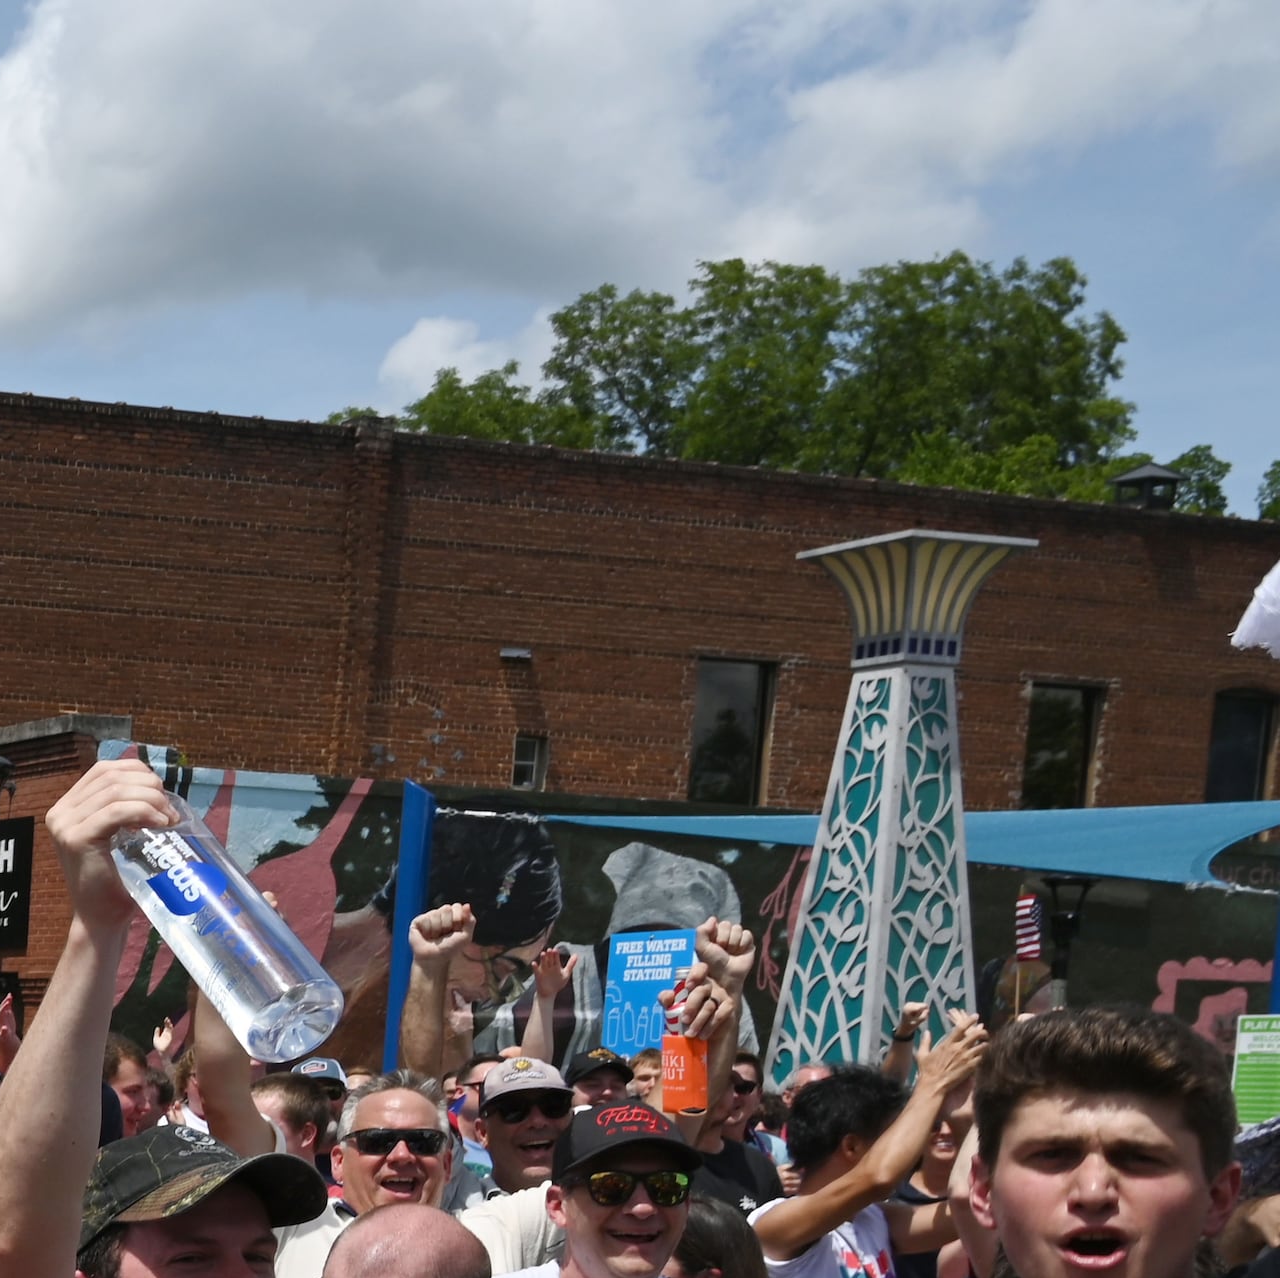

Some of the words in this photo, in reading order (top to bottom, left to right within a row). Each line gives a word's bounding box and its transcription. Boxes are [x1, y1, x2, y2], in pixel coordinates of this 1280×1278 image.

[141, 828, 208, 902] smart
[615, 941, 644, 955] FREE
[646, 938, 687, 953] WATER
[626, 953, 672, 968] FILLING
[623, 967, 673, 982] STATION
